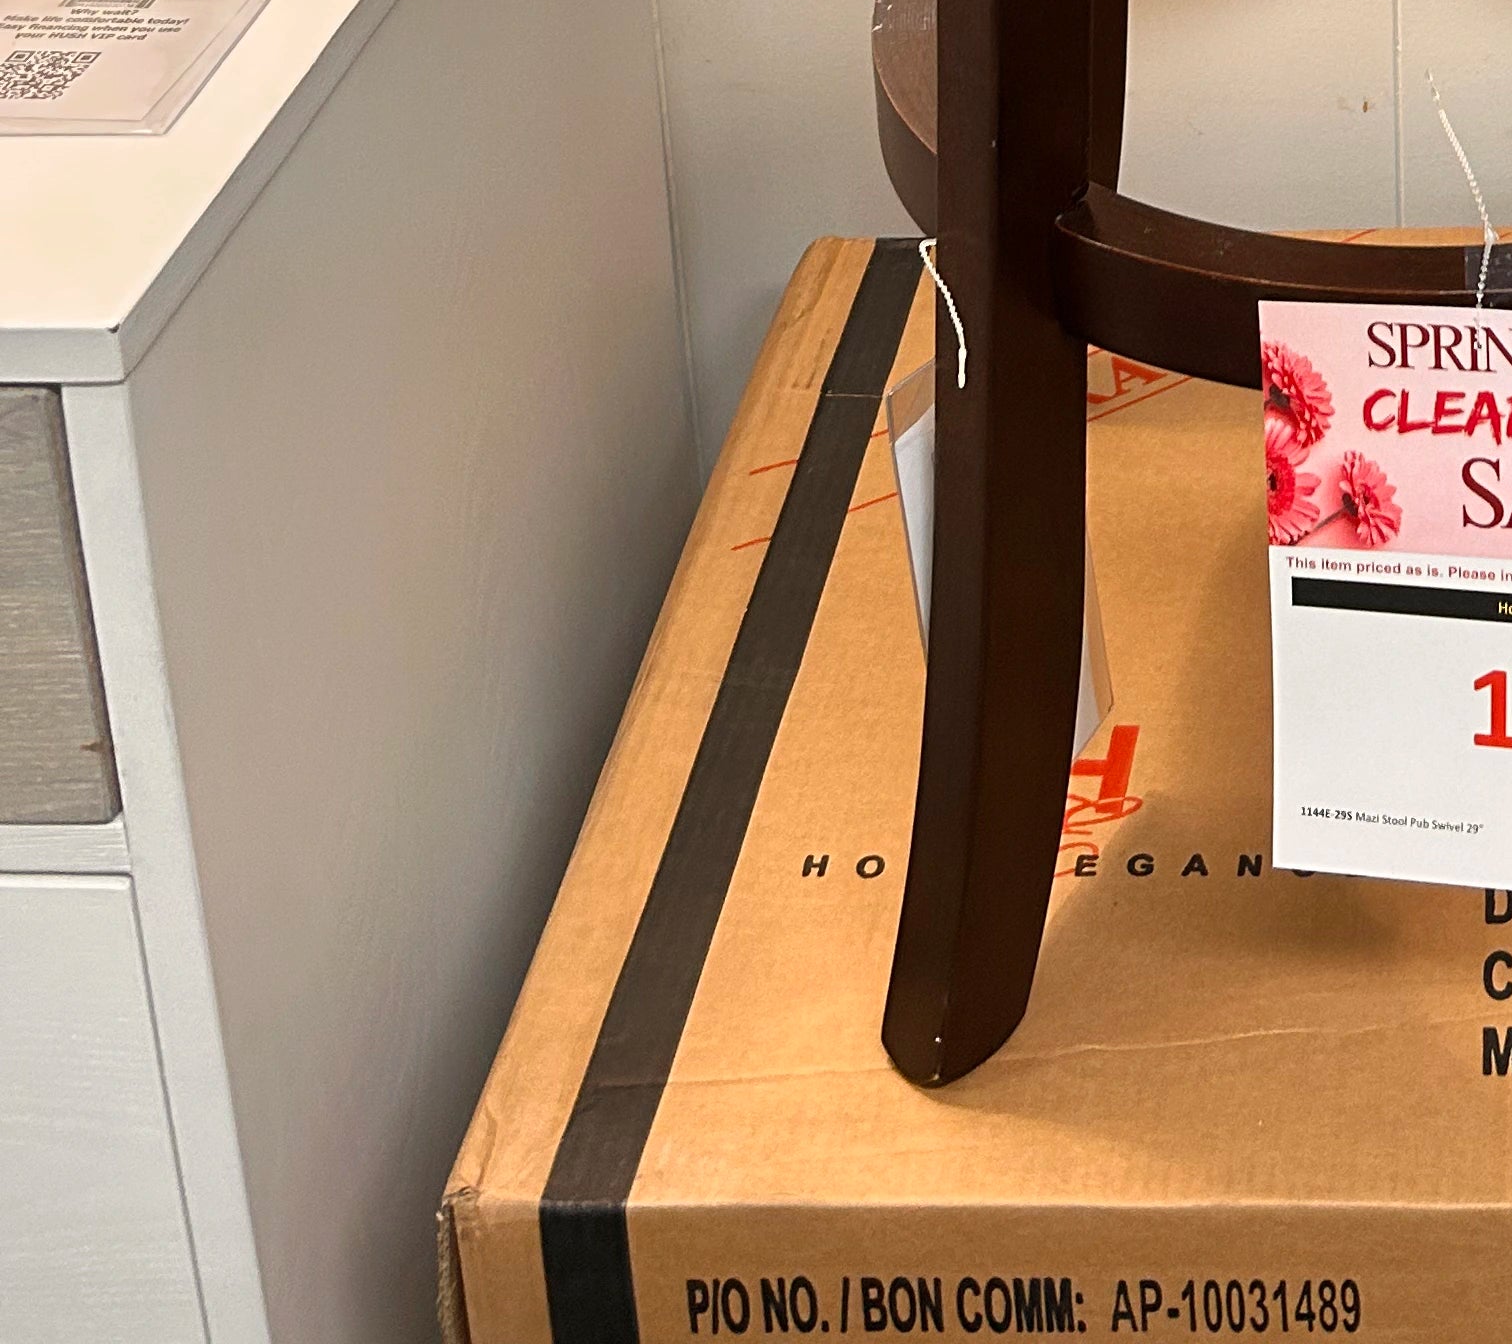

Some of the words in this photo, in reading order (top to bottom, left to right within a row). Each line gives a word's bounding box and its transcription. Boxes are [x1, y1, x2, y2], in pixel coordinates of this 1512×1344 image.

[65, 16, 145, 25] comfortable
[1286, 556, 1317, 570] This
[1321, 558, 1352, 572] item
[1356, 561, 1401, 576] priced
[1405, 565, 1422, 577] as
[1426, 564, 1444, 579] is.
[1448, 565, 1496, 581] Please
[1381, 814, 1408, 827] Stool
[1410, 817, 1430, 830] Pub
[1431, 819, 1465, 833] Swivel
[686, 1276, 750, 1334] P/O
[760, 1276, 830, 1334] NO.
[861, 1276, 945, 1334] BON
[956, 1276, 1087, 1334] COMM:
[1110, 1278, 1362, 1334] AP-10031489
